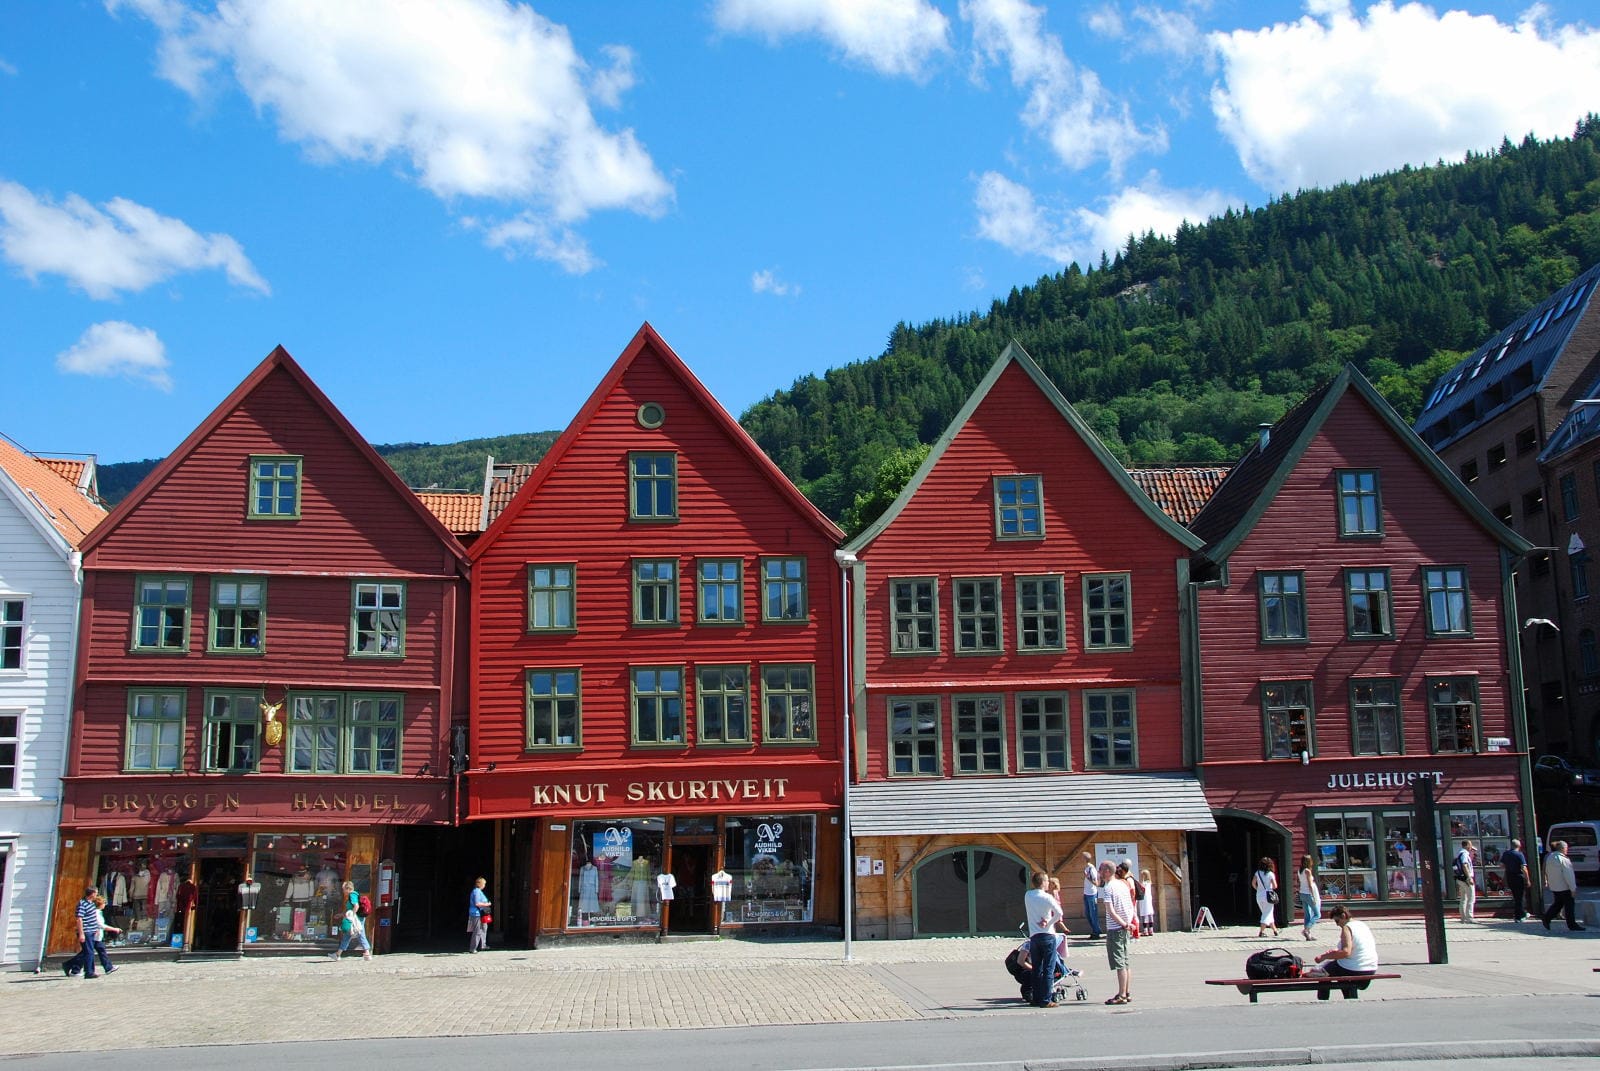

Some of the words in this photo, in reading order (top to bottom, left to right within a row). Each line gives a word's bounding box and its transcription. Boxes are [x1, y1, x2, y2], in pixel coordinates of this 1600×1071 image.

[101, 791, 241, 810] BRYGGEN
[292, 792, 406, 810] HANDEL
[532, 783, 609, 805] KNUT
[626, 778, 789, 802] SKURTVEIT
